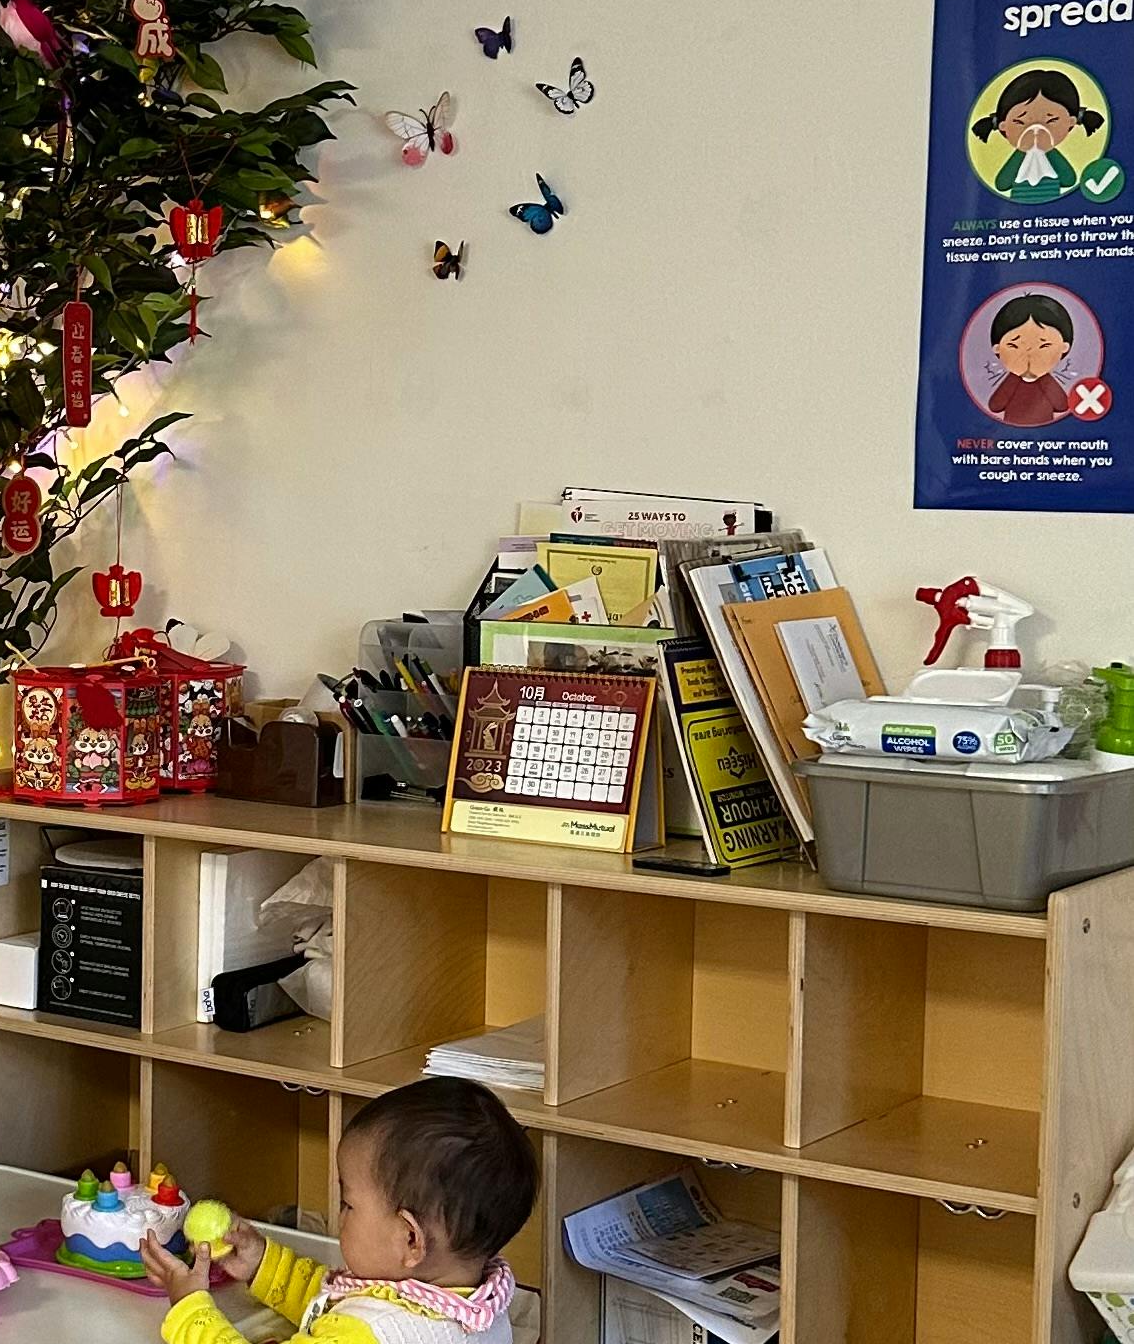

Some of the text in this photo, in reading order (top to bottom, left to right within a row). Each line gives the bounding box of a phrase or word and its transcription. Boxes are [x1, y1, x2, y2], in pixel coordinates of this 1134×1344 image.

[952, 214, 1134, 232] ALWAYS use a tissue when you
[942, 229, 1134, 248] sneeze. Don't forget to throw th
[946, 252, 980, 263] tissue
[981, 250, 1016, 262] away
[1018, 249, 1027, 260] &
[1030, 248, 1062, 260] wash
[1064, 248, 1094, 260] your
[957, 438, 1108, 452] NEVER cover your mouth
[952, 454, 1112, 468] with bare hands when you
[979, 470, 1083, 483] cough or sneeze.
[10, 491, 34, 543] 好运
[628, 512, 686, 522] 25 WAYS TO
[602, 521, 715, 538] GET MOVING
[519, 685, 596, 703] 10月 October
[886, 736, 930, 747] ALCOHOL
[956, 734, 1014, 746] 75% 50
[466, 758, 503, 773] 2023
[719, 795, 780, 824] 24 HOUR
[570, 820, 616, 833] MassMutual
